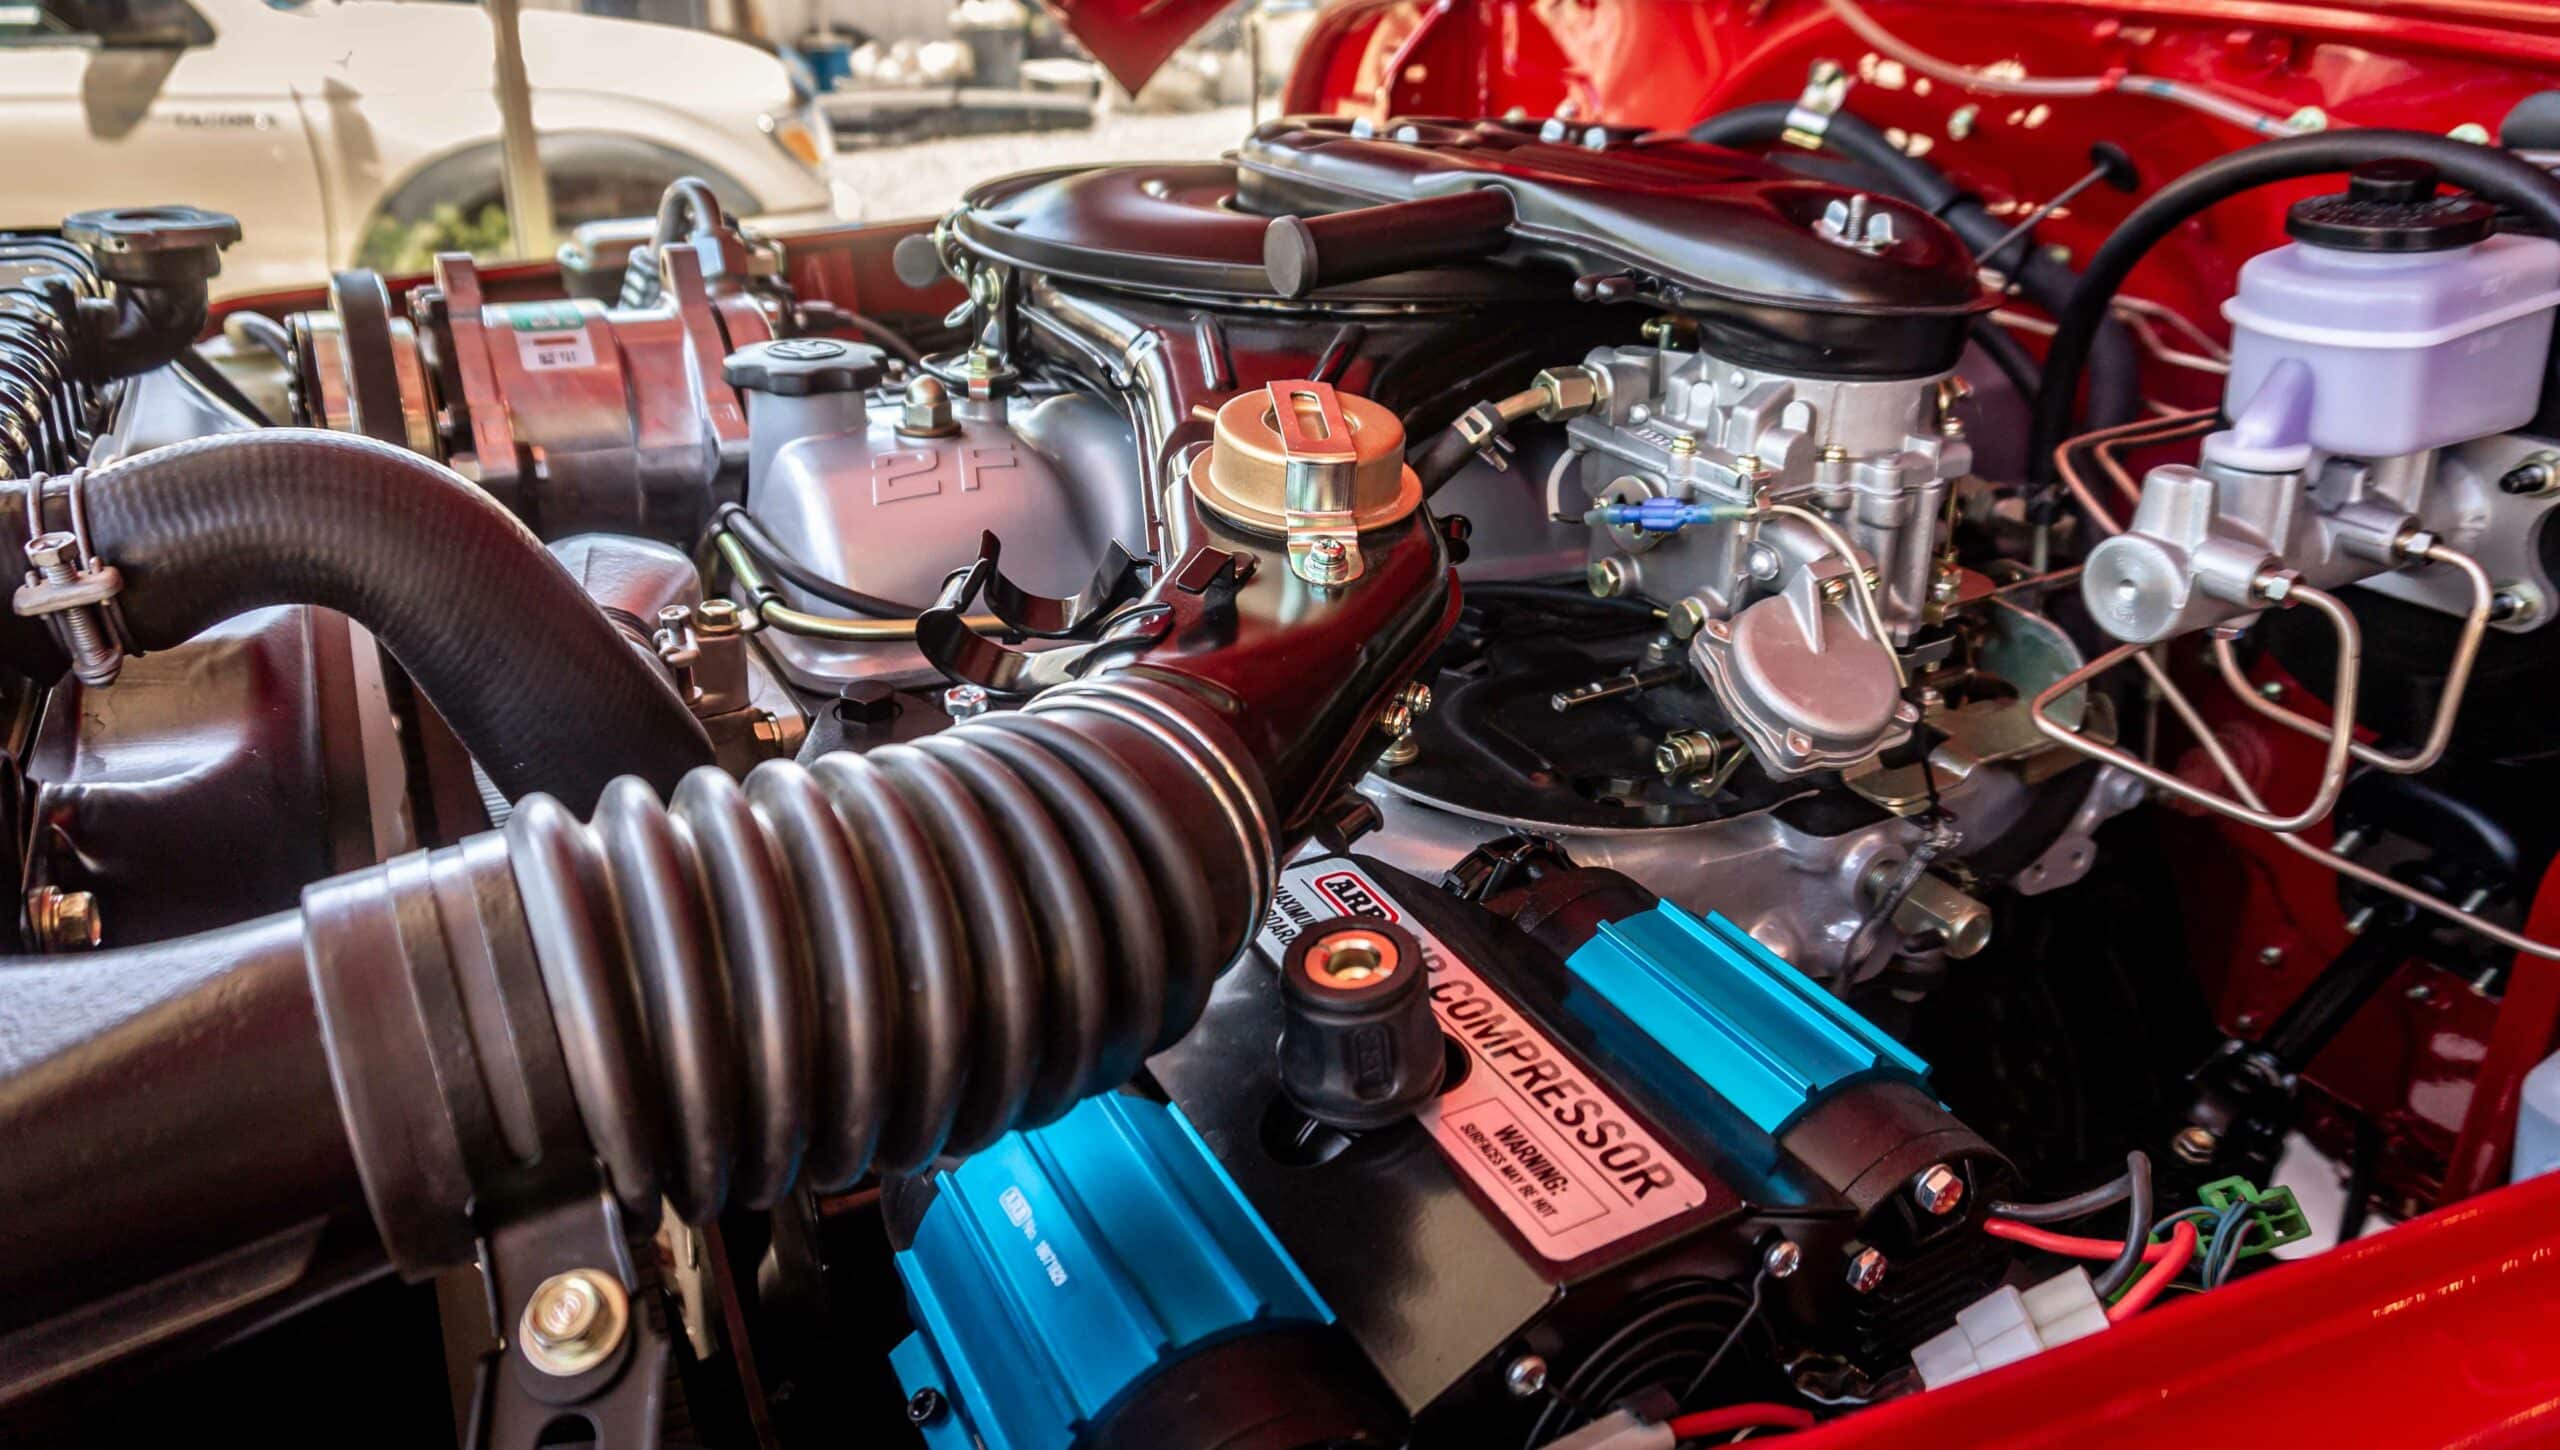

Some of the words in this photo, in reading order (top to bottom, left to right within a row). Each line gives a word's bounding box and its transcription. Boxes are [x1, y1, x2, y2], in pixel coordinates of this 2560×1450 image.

[872, 443, 1017, 506] 2F
[1430, 979, 1675, 1201] COMPRESSOR
[1494, 1124, 1568, 1196] WARNING:
[1501, 1164, 1526, 1184] MAY
[1518, 1184, 1538, 1198] BE
[1532, 1198, 1558, 1217] HOT
